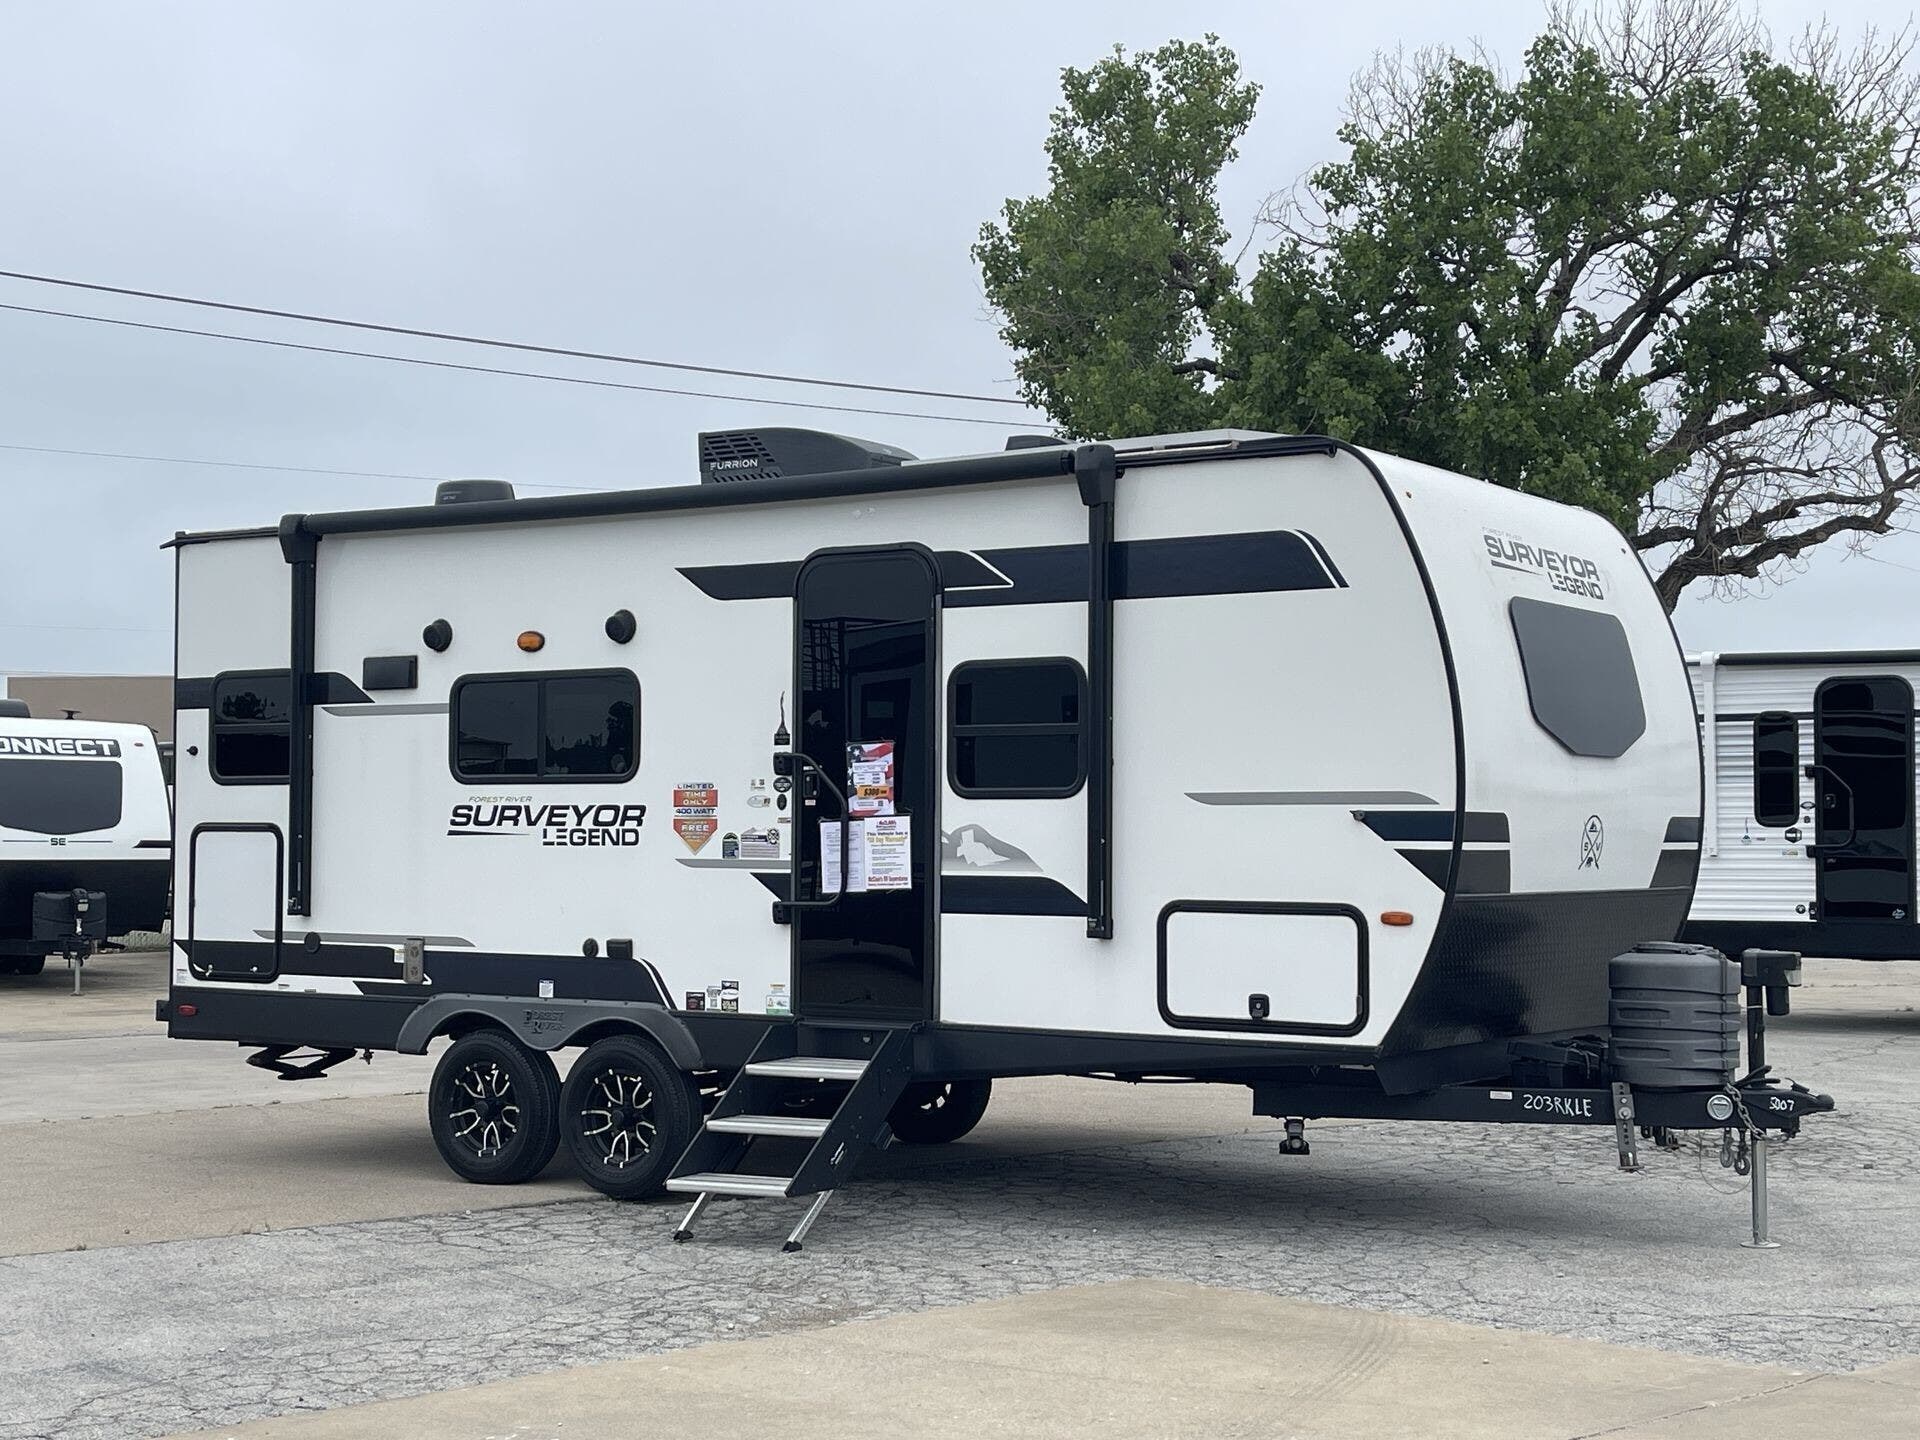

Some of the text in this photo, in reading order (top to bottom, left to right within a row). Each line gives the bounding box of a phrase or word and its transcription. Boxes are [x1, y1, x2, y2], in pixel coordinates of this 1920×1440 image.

[710, 458, 759, 470] FURRION
[1483, 534, 1600, 581] SURVEYOR
[1547, 571, 1604, 600] LEGEND
[449, 804, 647, 827] SURVEYOR
[676, 807, 716, 815] 400 WATT
[681, 824, 710, 832] FREE
[50, 837, 67, 846] SE
[542, 828, 640, 846] LEGEND
[1584, 842, 1601, 851] S V
[1523, 1094, 1593, 1117] 203RKLE
